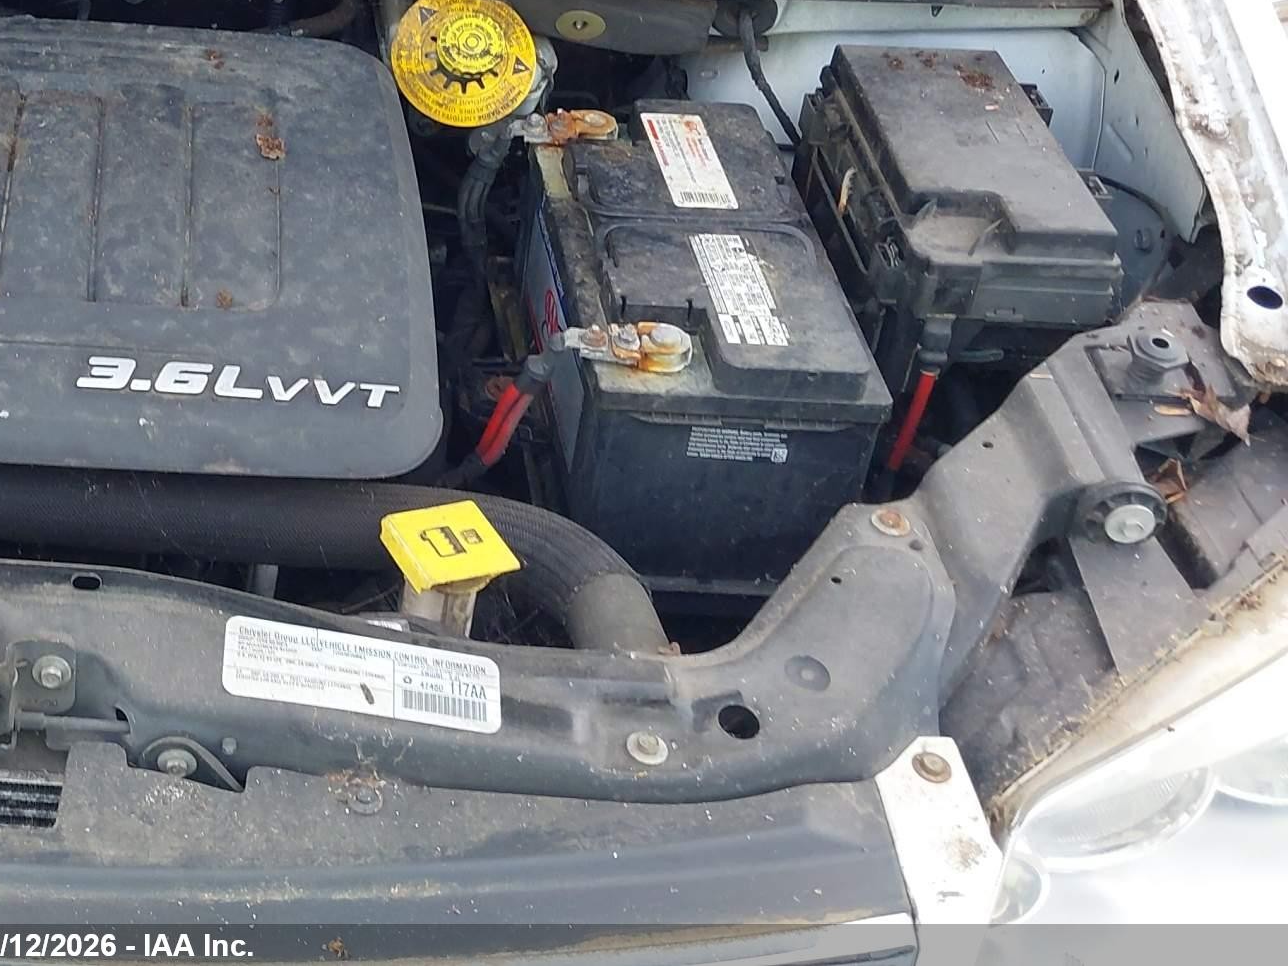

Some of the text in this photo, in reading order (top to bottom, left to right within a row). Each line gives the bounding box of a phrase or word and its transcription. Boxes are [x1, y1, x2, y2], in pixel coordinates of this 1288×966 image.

[76, 356, 400, 408] 3.6L VVT
[354, 644, 391, 659] EMISSION
[432, 657, 486, 675] INFORMATION
